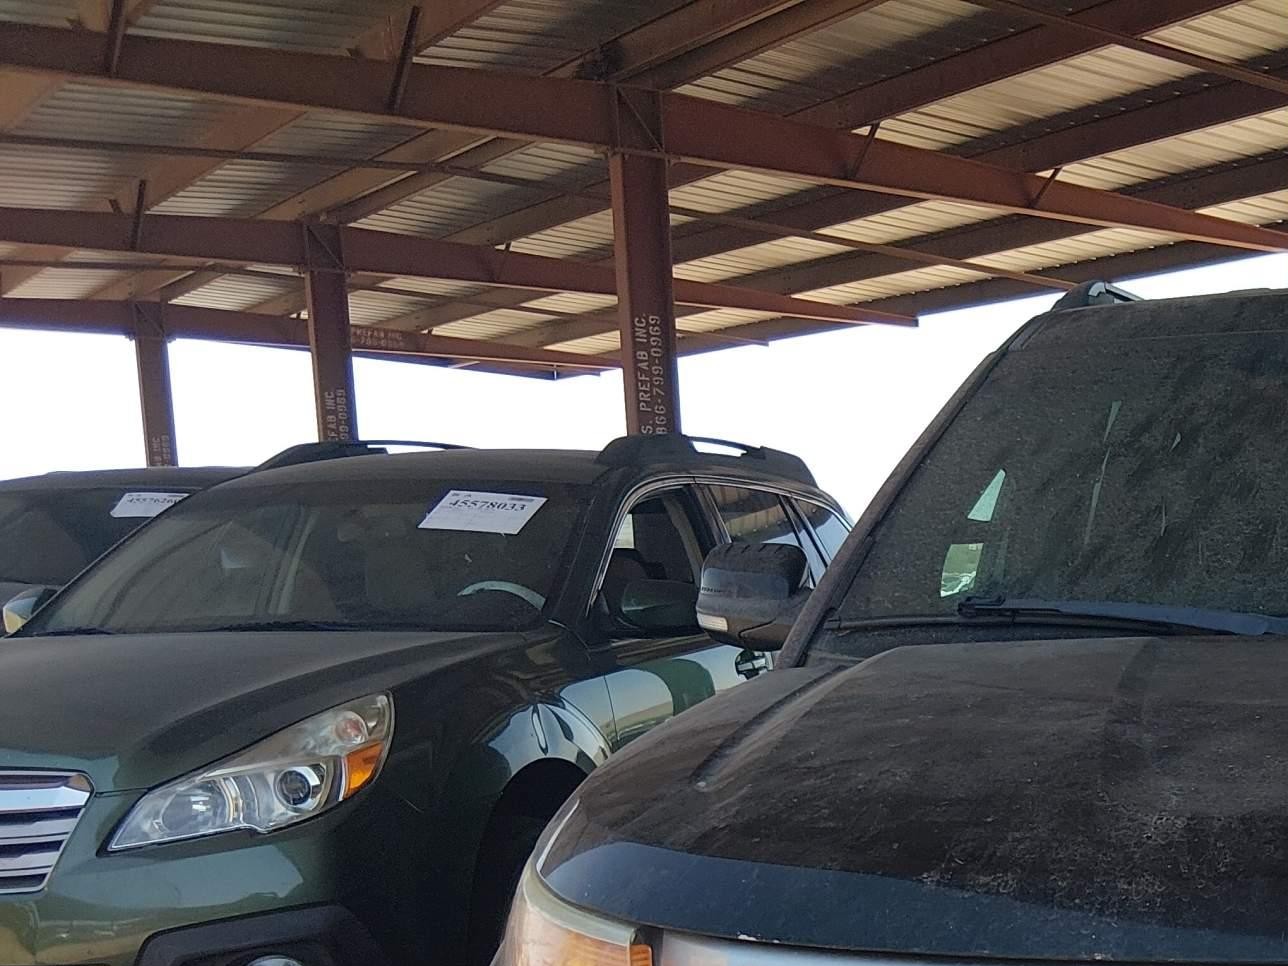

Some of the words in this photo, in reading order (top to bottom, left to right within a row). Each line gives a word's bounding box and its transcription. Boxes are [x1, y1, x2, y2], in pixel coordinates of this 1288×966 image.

[634, 313, 647, 343] INC.
[636, 351, 652, 412] PREFAB
[448, 499, 527, 512] 45578033
